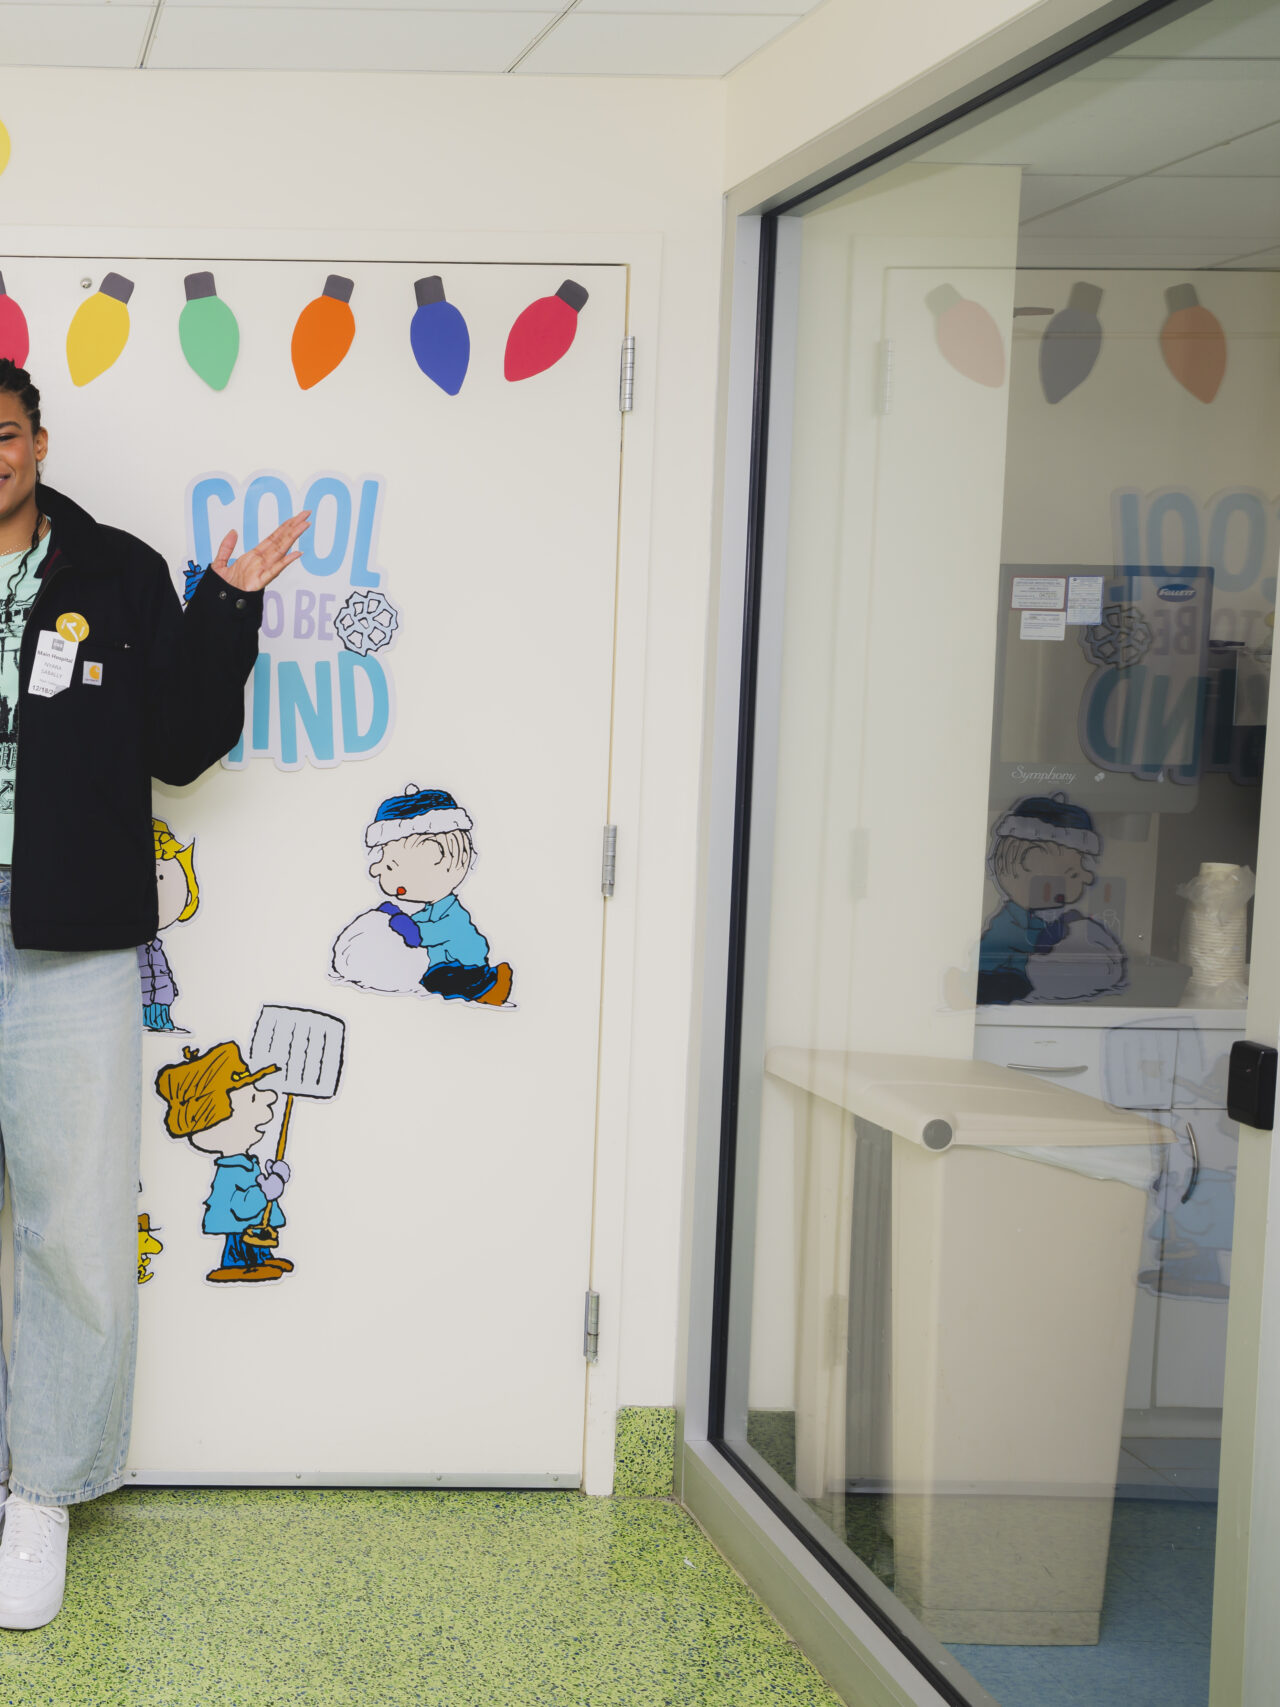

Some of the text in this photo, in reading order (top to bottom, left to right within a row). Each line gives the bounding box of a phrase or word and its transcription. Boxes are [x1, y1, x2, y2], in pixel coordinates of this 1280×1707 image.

[261, 589, 336, 641] O BE
[37, 650, 74, 664] Main Hospital
[228, 651, 389, 764] IND
[1011, 764, 1076, 785] Symphony
